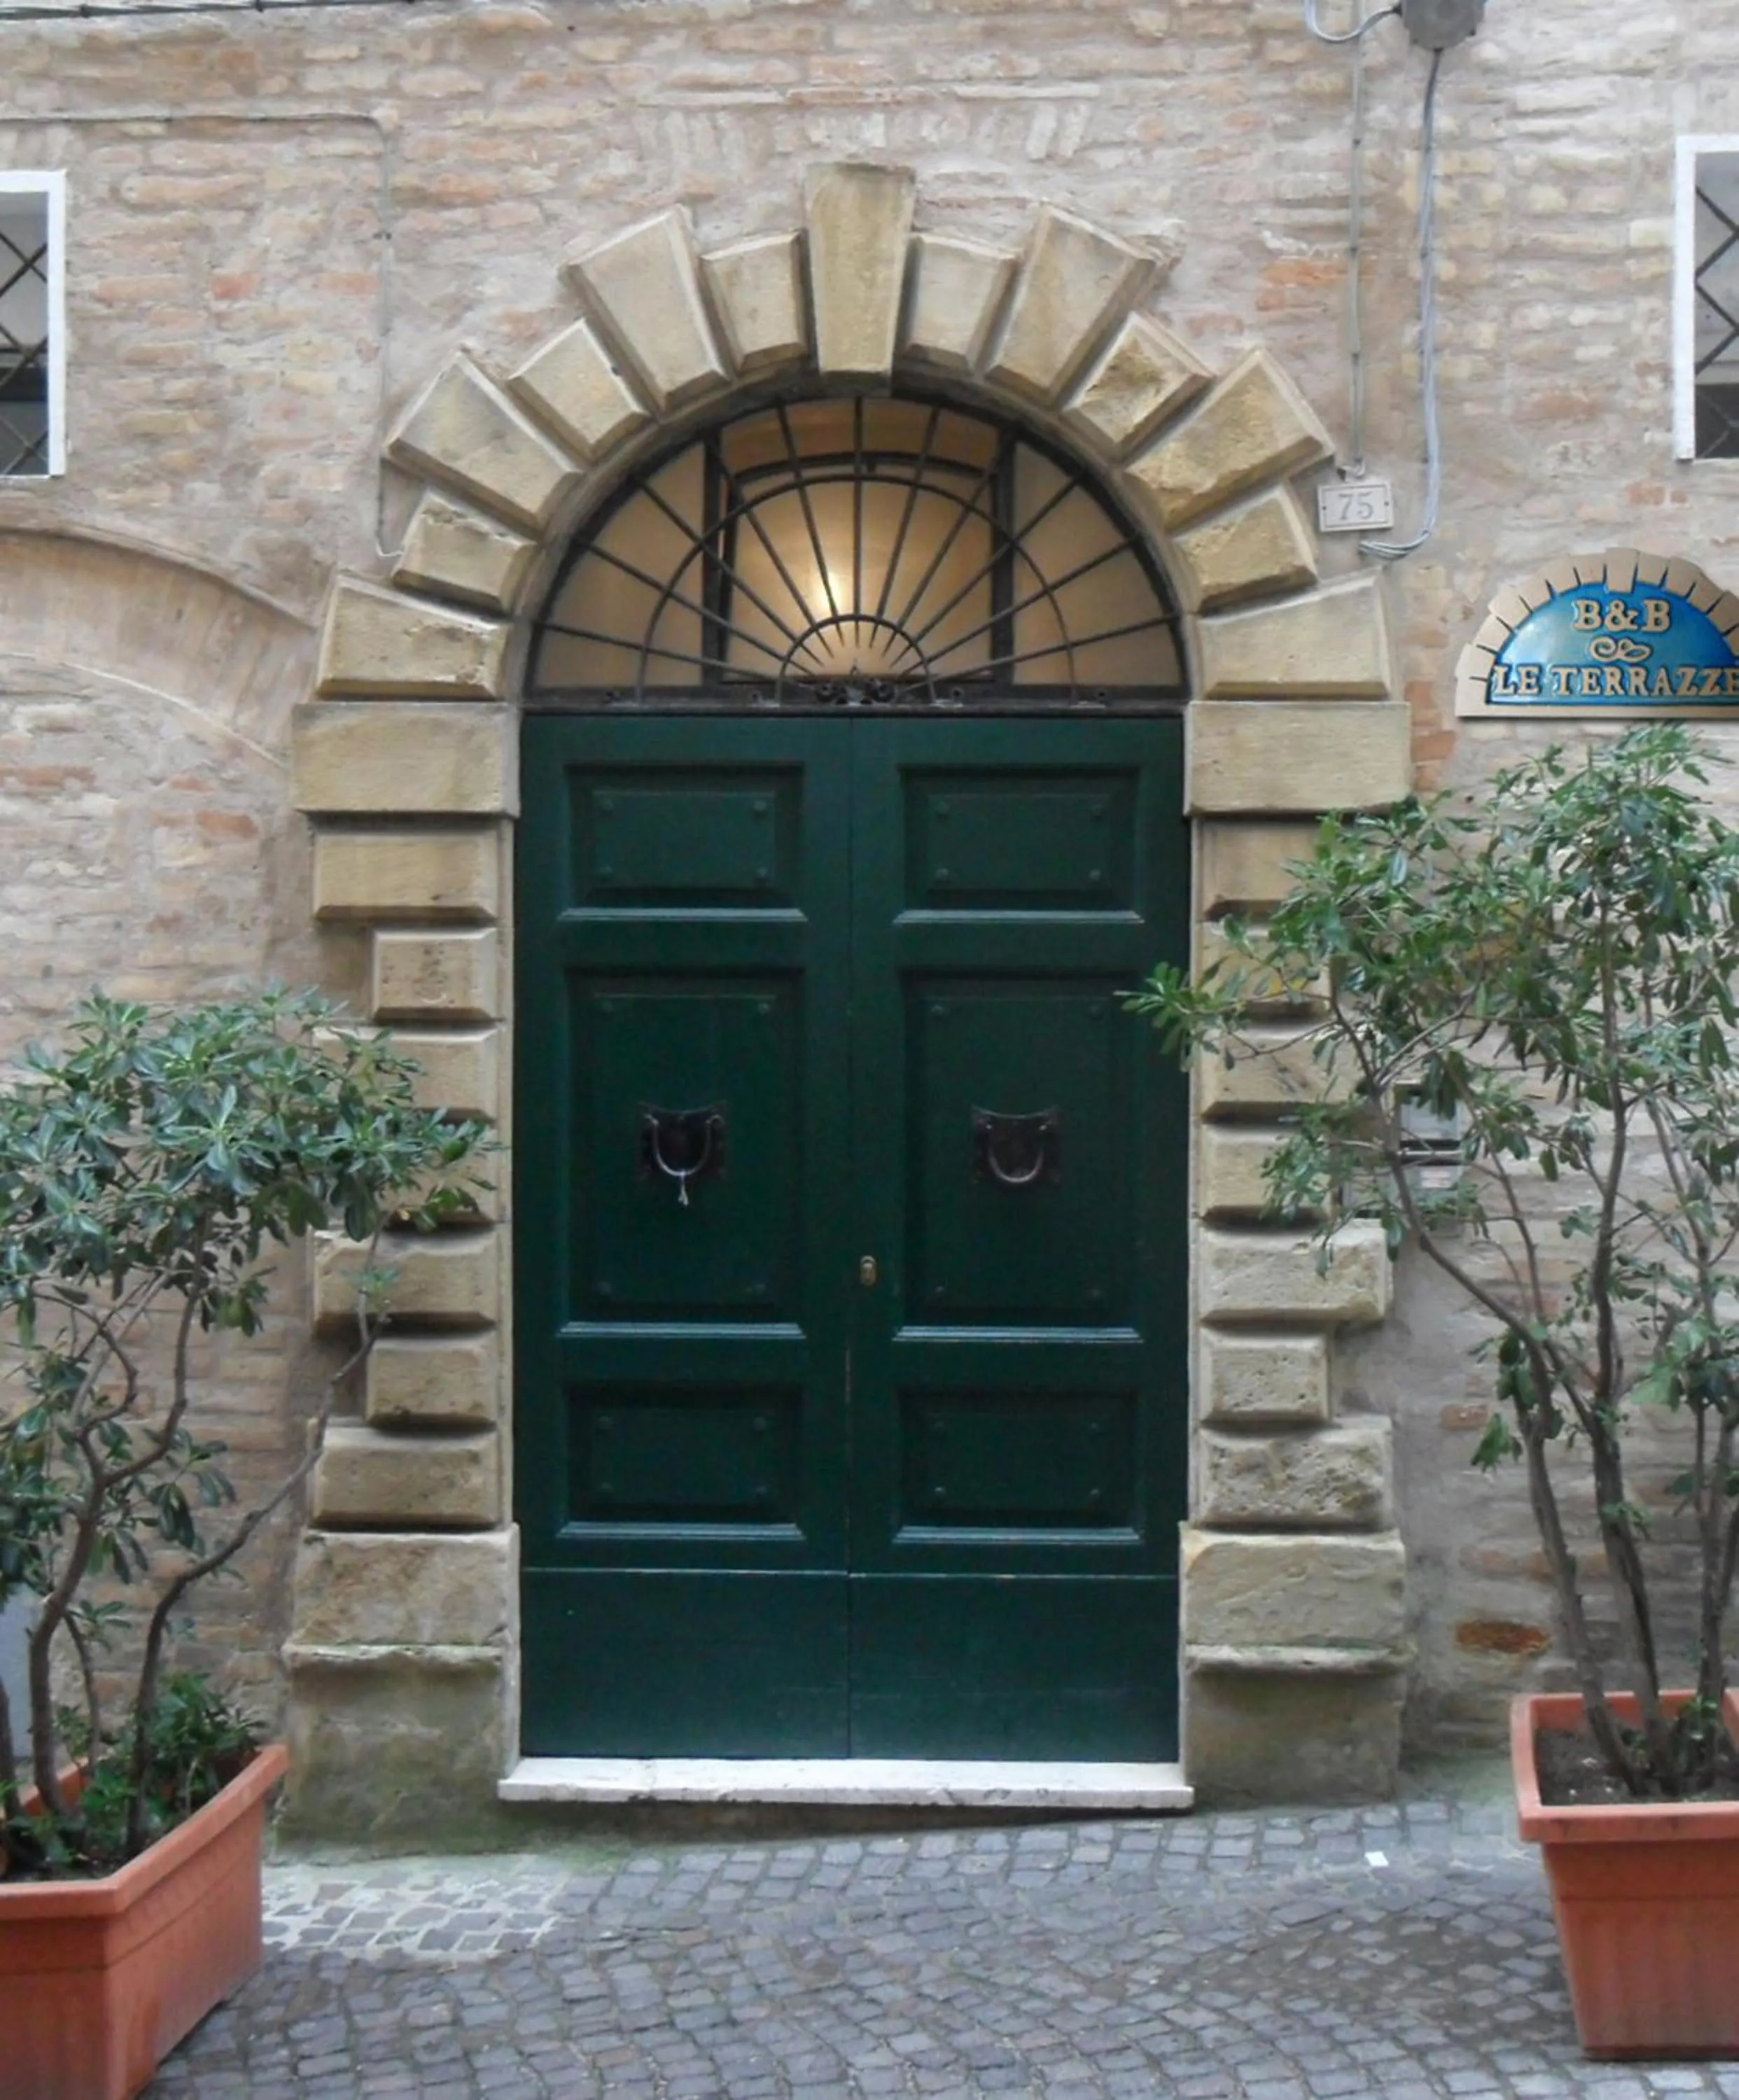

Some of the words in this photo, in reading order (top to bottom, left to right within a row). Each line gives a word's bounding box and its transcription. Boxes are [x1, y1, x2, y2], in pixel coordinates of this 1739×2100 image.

[1338, 491, 1374, 521] 75
[1573, 598, 1671, 633] B&B
[1494, 666, 1542, 695] LE
[1551, 666, 1739, 696] TERRAZZE
